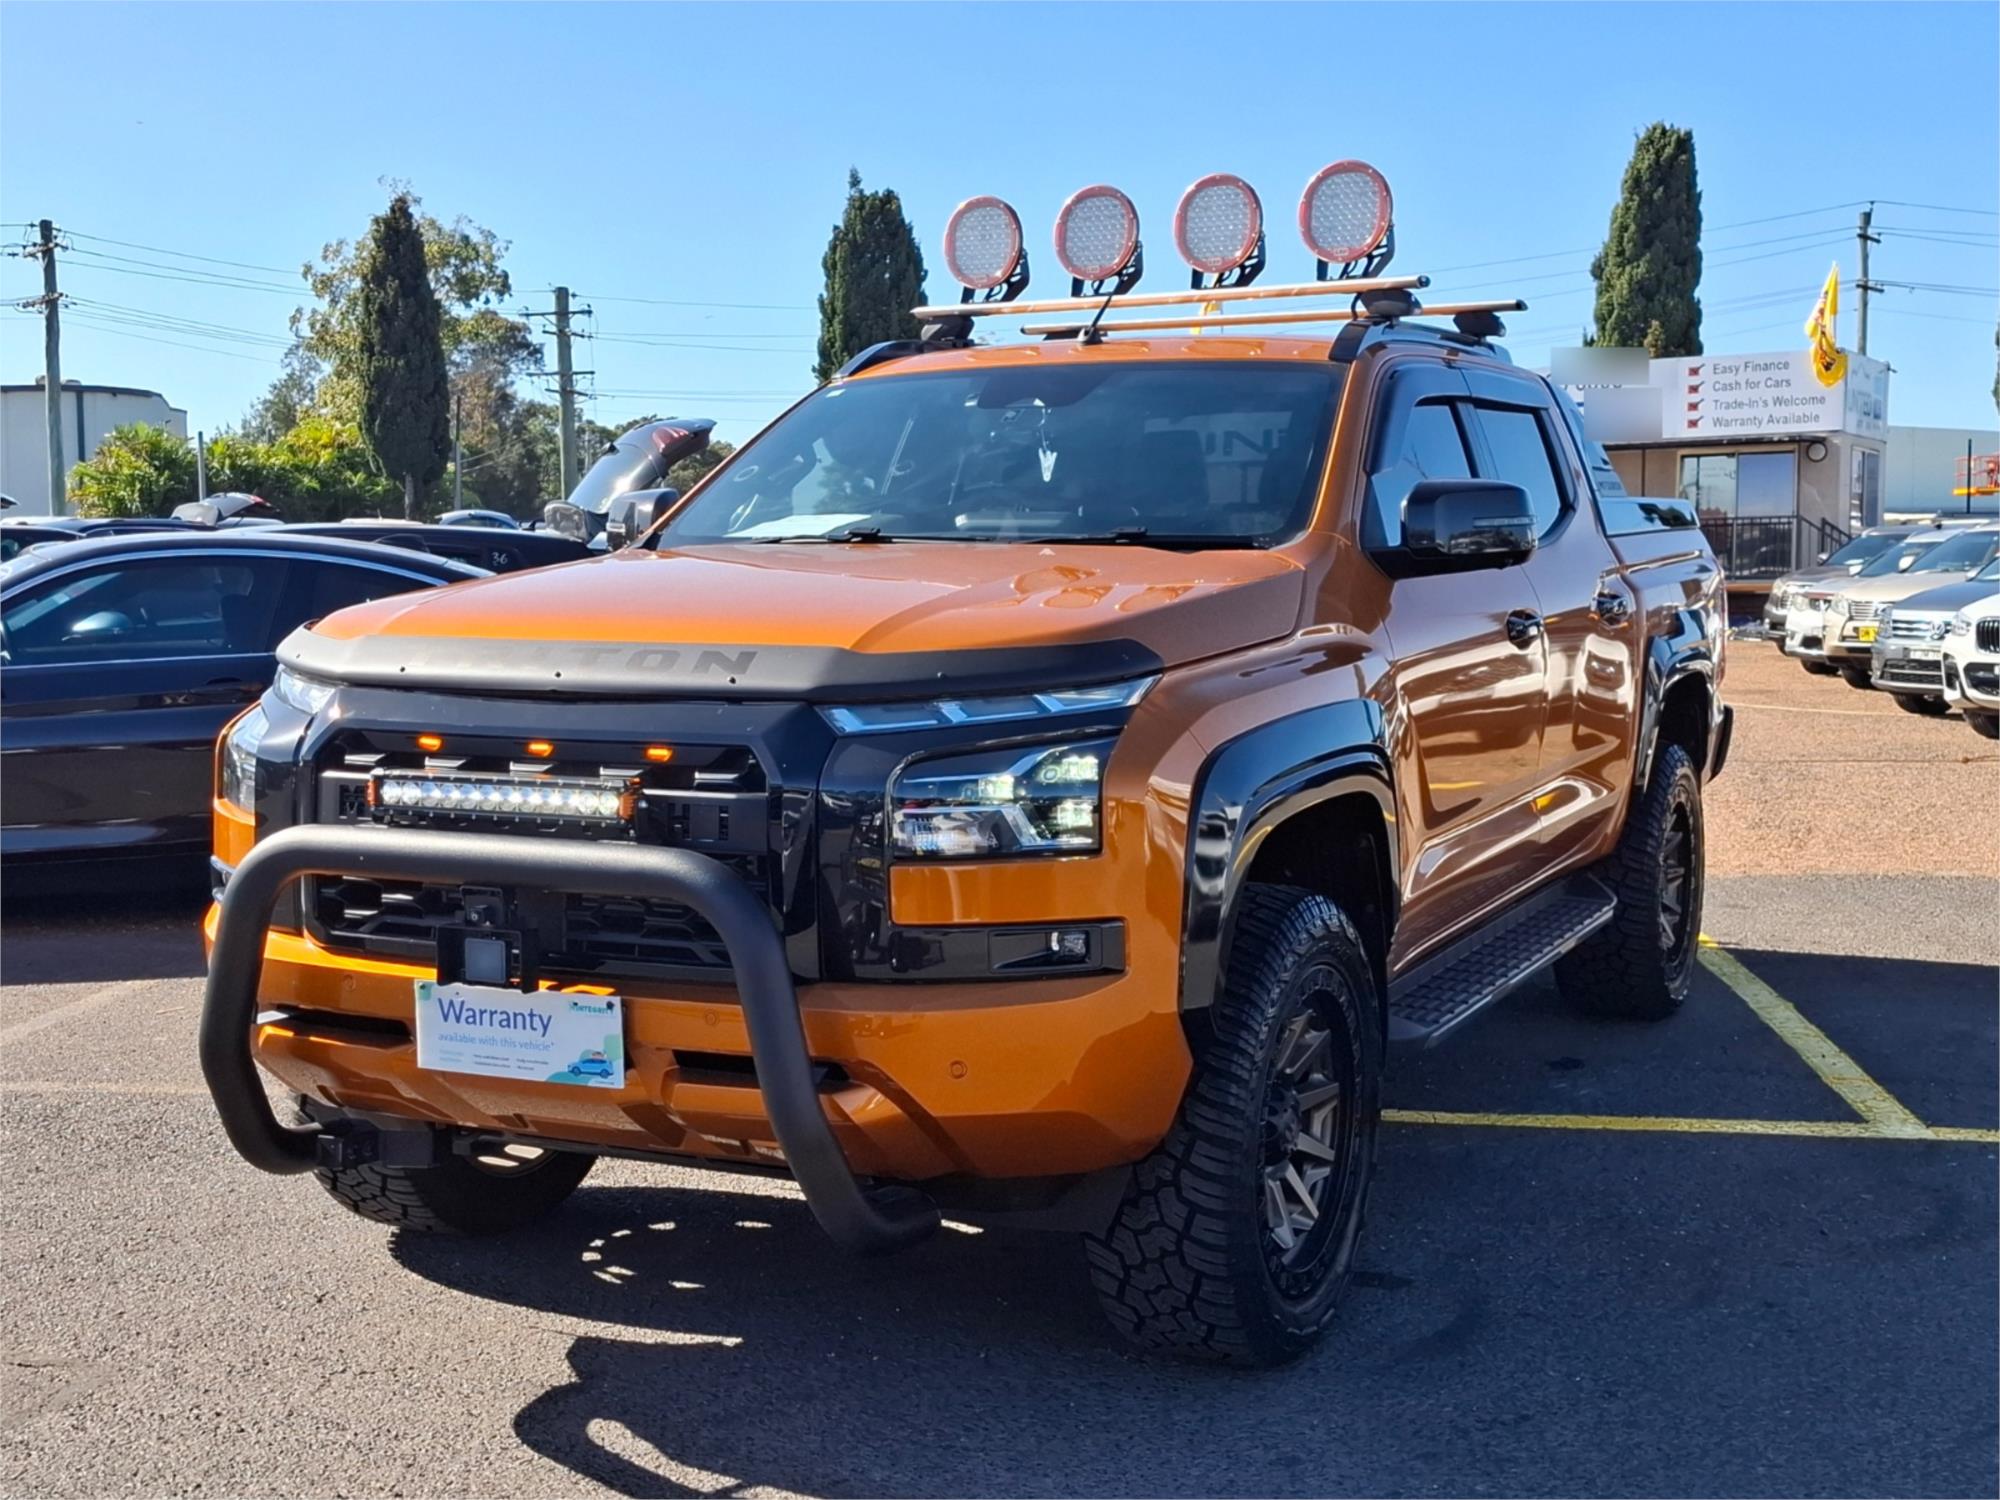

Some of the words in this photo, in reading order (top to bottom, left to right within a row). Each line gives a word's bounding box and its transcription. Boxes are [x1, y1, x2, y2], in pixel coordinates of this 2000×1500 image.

[1712, 363, 1740, 376] Easy
[1743, 360, 1790, 372] Finance
[1712, 380, 1742, 392] Cash
[1744, 379, 1763, 390] for
[1765, 377, 1791, 389] Cars
[1713, 397, 1769, 410] Trade-In's
[1771, 394, 1826, 408] Welcome
[1712, 415, 1763, 428] Warranty
[1766, 412, 1820, 425] Available
[491, 551, 508, 566] 36
[437, 997, 552, 1038] Warranty
[437, 1032, 477, 1045] available
[478, 1033, 499, 1046] with
[500, 1035, 517, 1049] this
